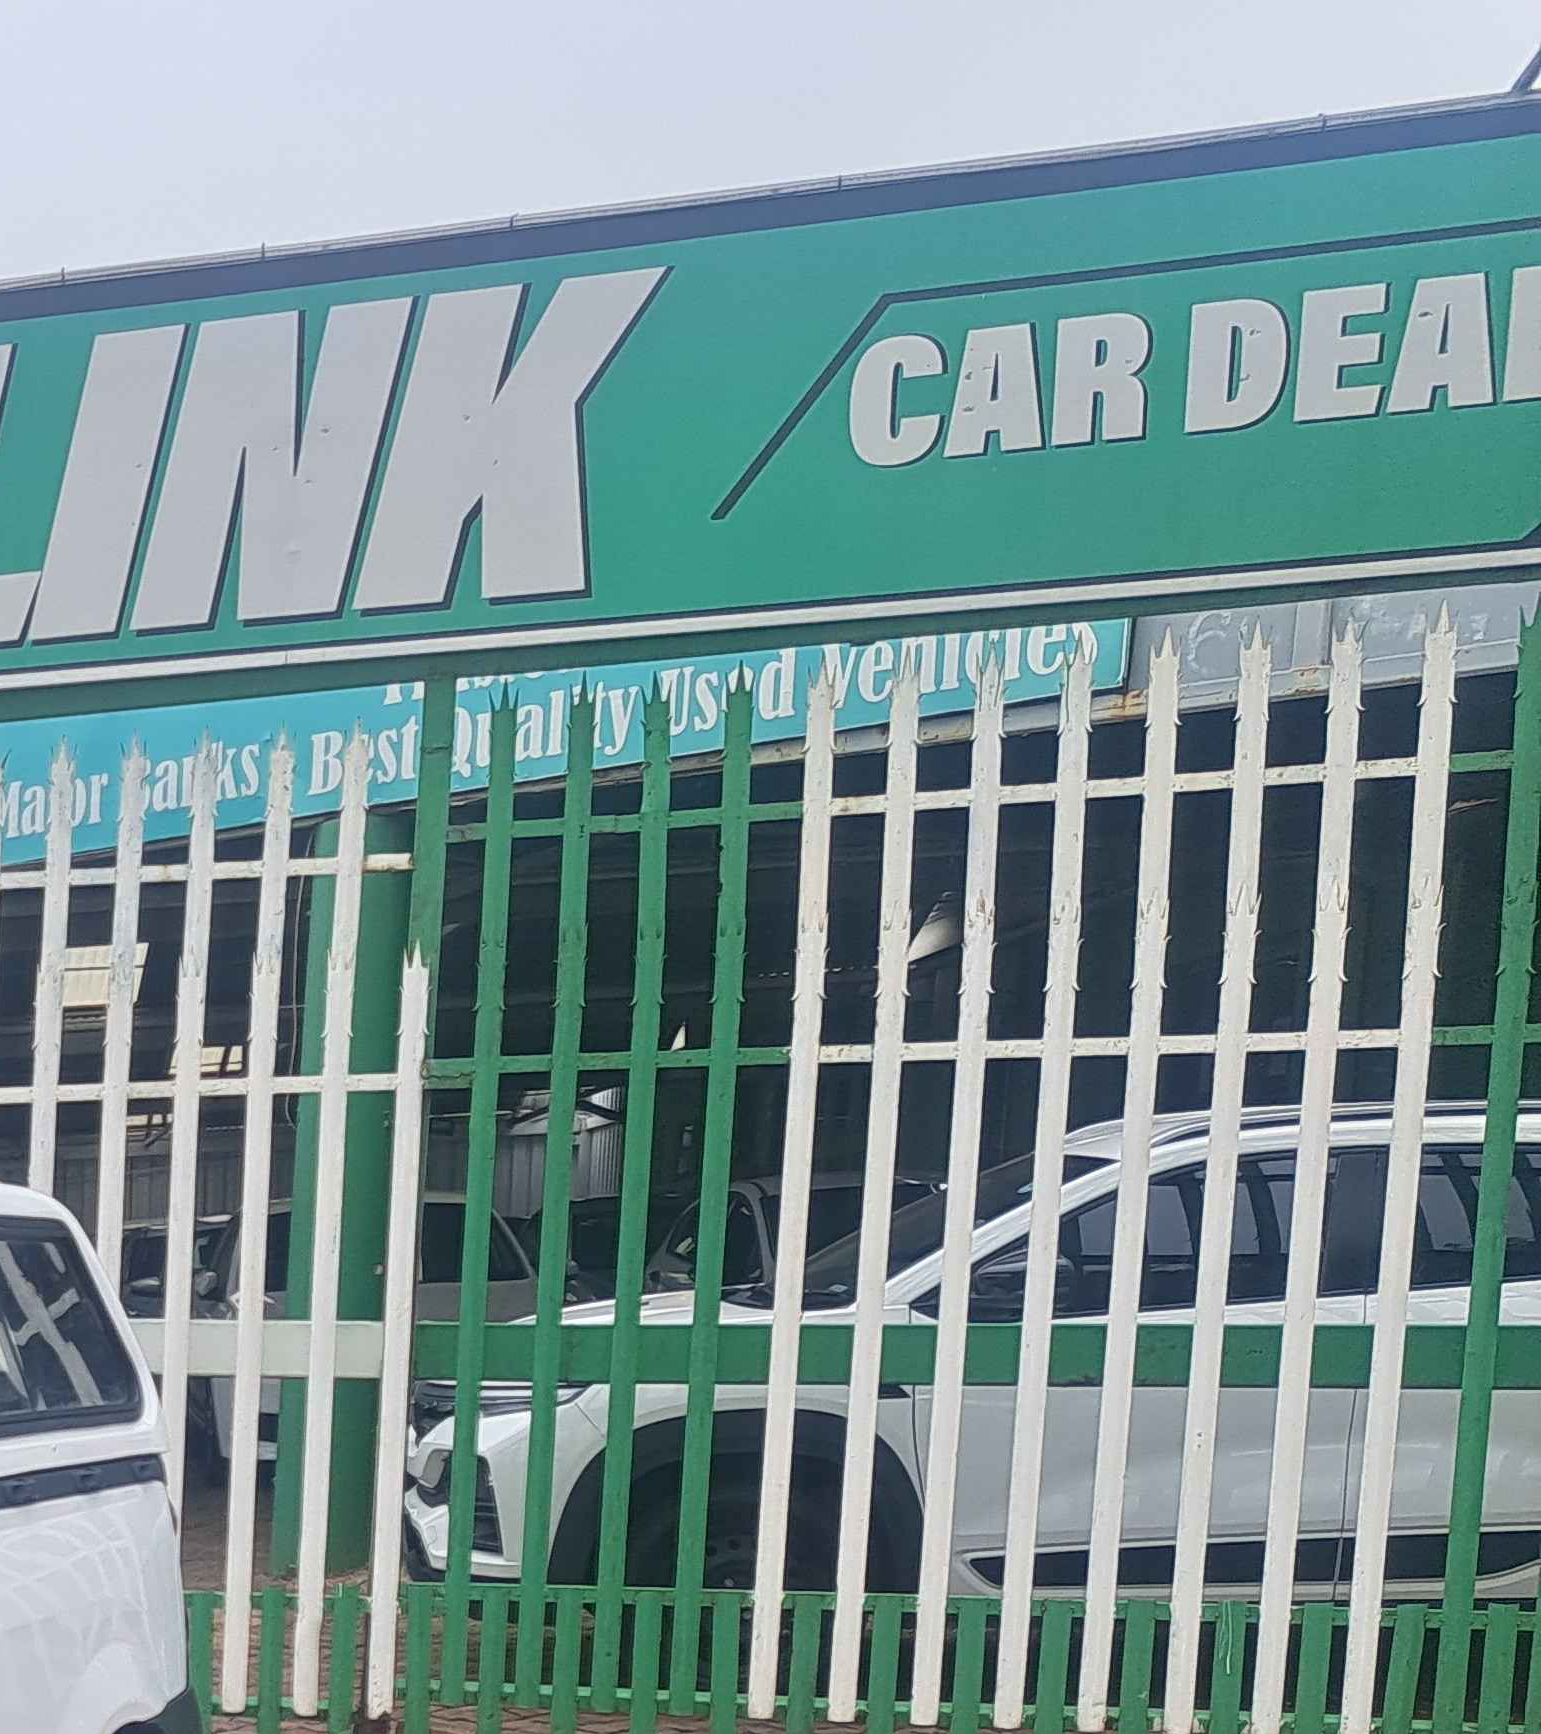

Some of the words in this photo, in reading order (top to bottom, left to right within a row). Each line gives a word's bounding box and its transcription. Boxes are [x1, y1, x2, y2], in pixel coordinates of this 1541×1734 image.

[848, 313, 1152, 467] CAR
[453, 680, 639, 778] Qalty
[0, 772, 107, 838] Maor
